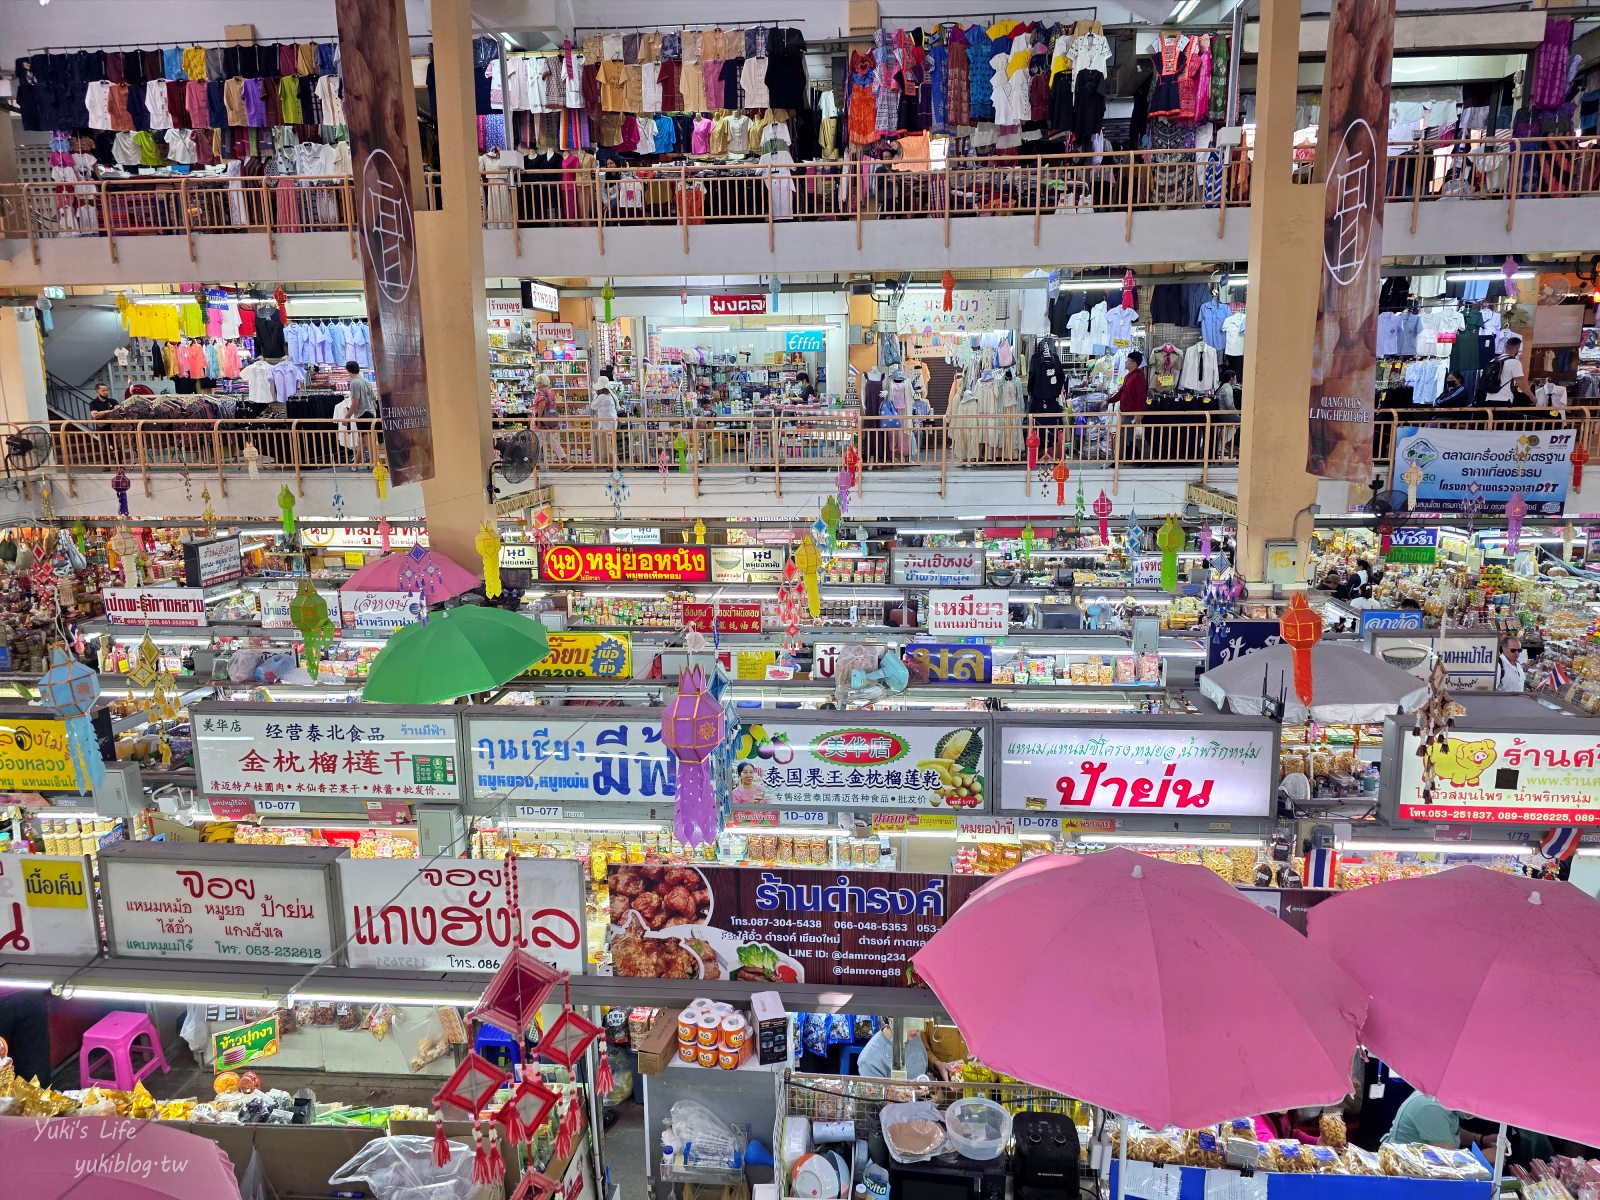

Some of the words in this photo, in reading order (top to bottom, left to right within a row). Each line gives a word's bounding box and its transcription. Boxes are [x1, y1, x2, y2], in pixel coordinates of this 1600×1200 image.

[550, 554, 576, 578] นุช
[586, 548, 705, 579] หมูยอหนัง
[1271, 550, 1293, 569] 15
[934, 594, 1003, 616] เหมียว
[934, 617, 1003, 629] แหนมป้าย่น
[202, 718, 242, 733] 美华店
[265, 723, 385, 743] 经营泰北食品
[400, 723, 447, 736] ร้านมีฟ้า
[477, 727, 585, 770] กุนเชียง
[825, 735, 893, 759] 美华店
[1503, 737, 1600, 768] ร้านศ
[477, 771, 589, 793] หมูหยอง,หมูแผ่น
[764, 766, 942, 789] 泰国果王金枕榴莲乾
[1055, 760, 1215, 809] ป้าย่น
[258, 801, 296, 810] 1D-077
[898, 794, 928, 805] 批发价
[1514, 785, 1592, 808] น้ำพริกหนุ่ม
[519, 807, 559, 816] 1D-077
[784, 811, 824, 821] 1D-078
[1018, 817, 1059, 827] 1D-078
[1506, 831, 1530, 841] 1/79
[25, 868, 83, 896] เนื้อเค็ม
[175, 870, 256, 901] จอย
[418, 868, 503, 888] จอย
[755, 873, 945, 917] ร้านดำรงค์
[126, 897, 192, 913] แหนมหม้อ
[204, 902, 245, 921] หมูยอ
[260, 894, 315, 920] ป้าย่น
[156, 915, 193, 935] ไส้อั่ว
[353, 889, 581, 950] แกงฮังเล
[833, 921, 908, 933] 066-048-5353
[215, 940, 242, 955] โทร.
[246, 946, 322, 959] 053-232618
[765, 932, 797, 943] ดำรงค์
[799, 932, 841, 944] เชียงใหม่
[858, 935, 891, 946] ดำรงค์
[893, 937, 931, 948] กาดหล
[447, 954, 475, 969] โทร.
[788, 949, 812, 958] LINE
[815, 949, 829, 958] ID:
[831, 949, 906, 963] @damrong234
[832, 964, 902, 978] @damrong88
[219, 1026, 273, 1050] ข้าวปุกงา
